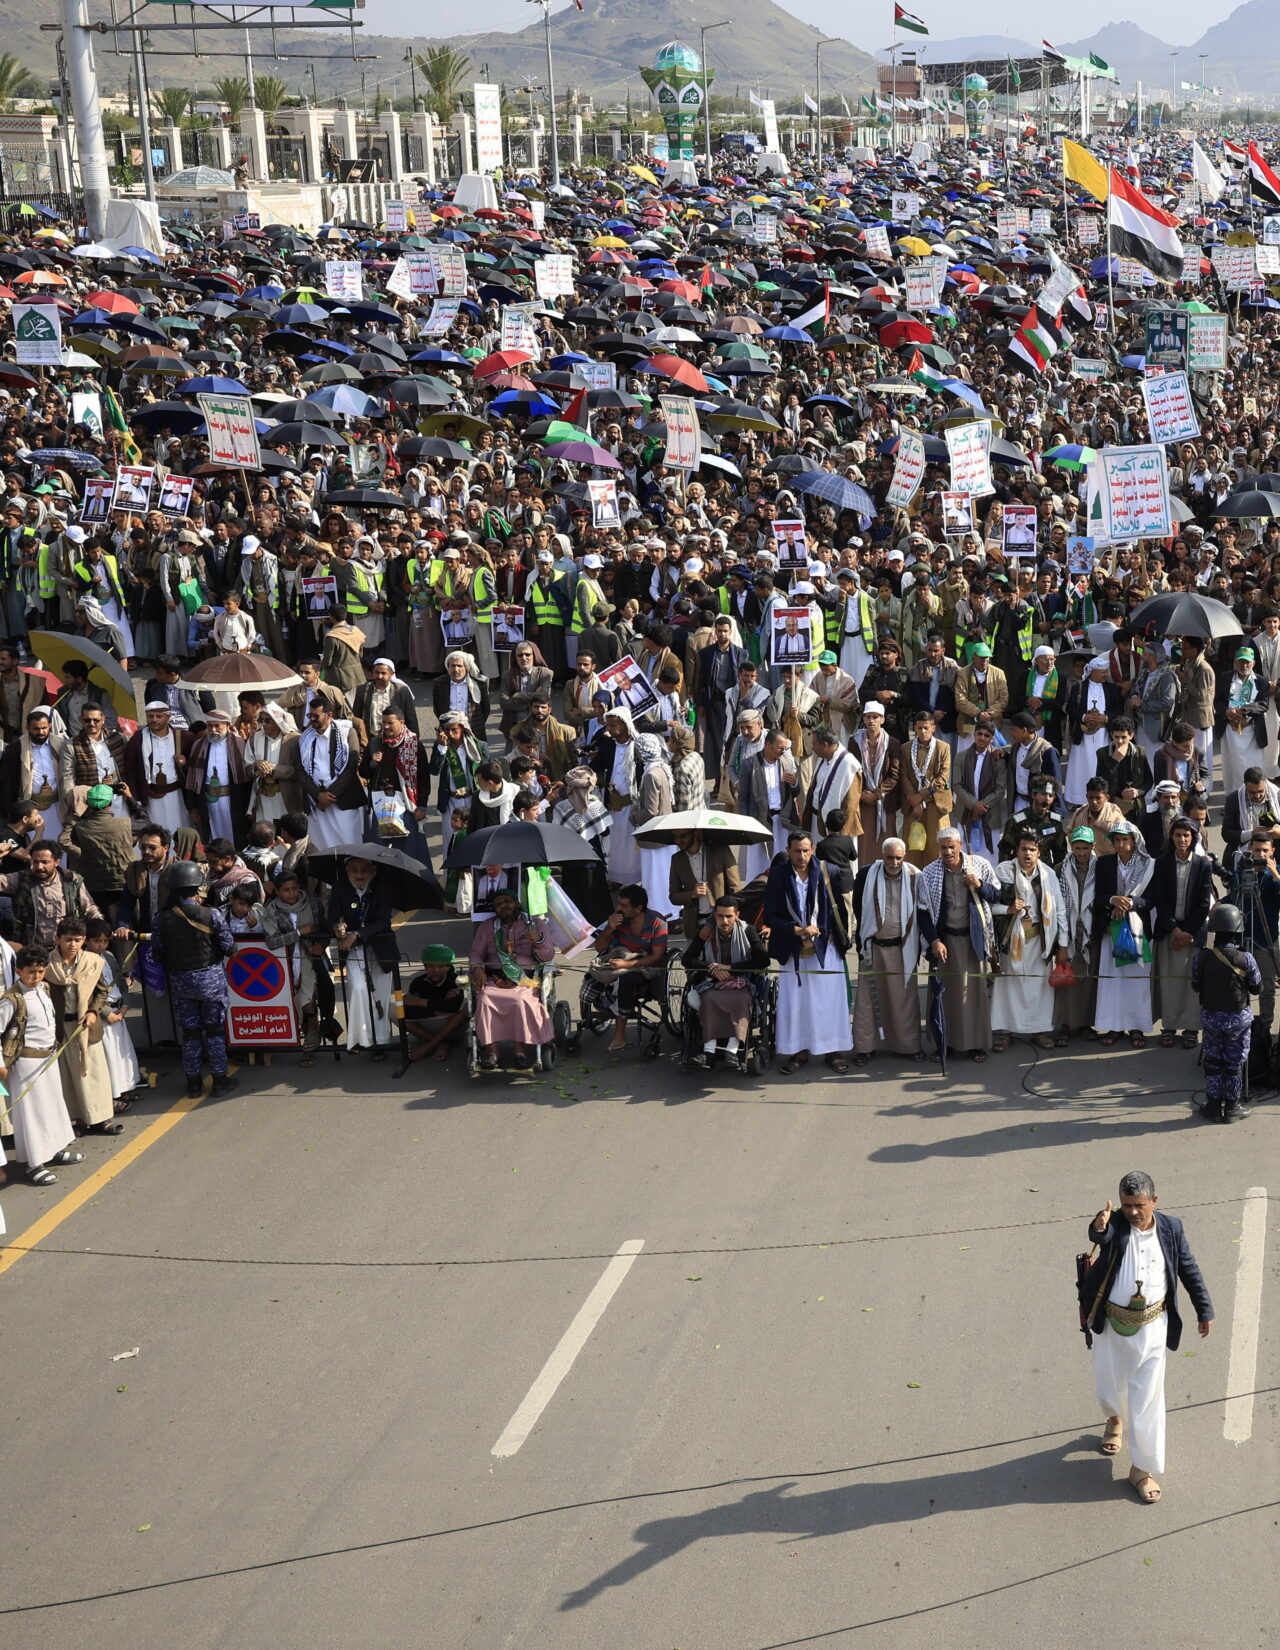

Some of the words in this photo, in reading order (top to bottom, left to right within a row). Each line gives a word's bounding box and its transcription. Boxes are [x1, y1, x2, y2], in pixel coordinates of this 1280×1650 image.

[1140, 456, 1160, 470] الله
[1138, 474, 1160, 486] الموت
[1140, 488, 1162, 500] الموت
[1112, 506, 1132, 518] اليهود
[1134, 508, 1144, 517] على
[1143, 516, 1166, 532] النصر
[234, 1012, 264, 1022] الوقوف
[266, 1013, 288, 1022] ممنوع
[239, 1024, 266, 1034] الضريح
[270, 1023, 286, 1034] أمام
